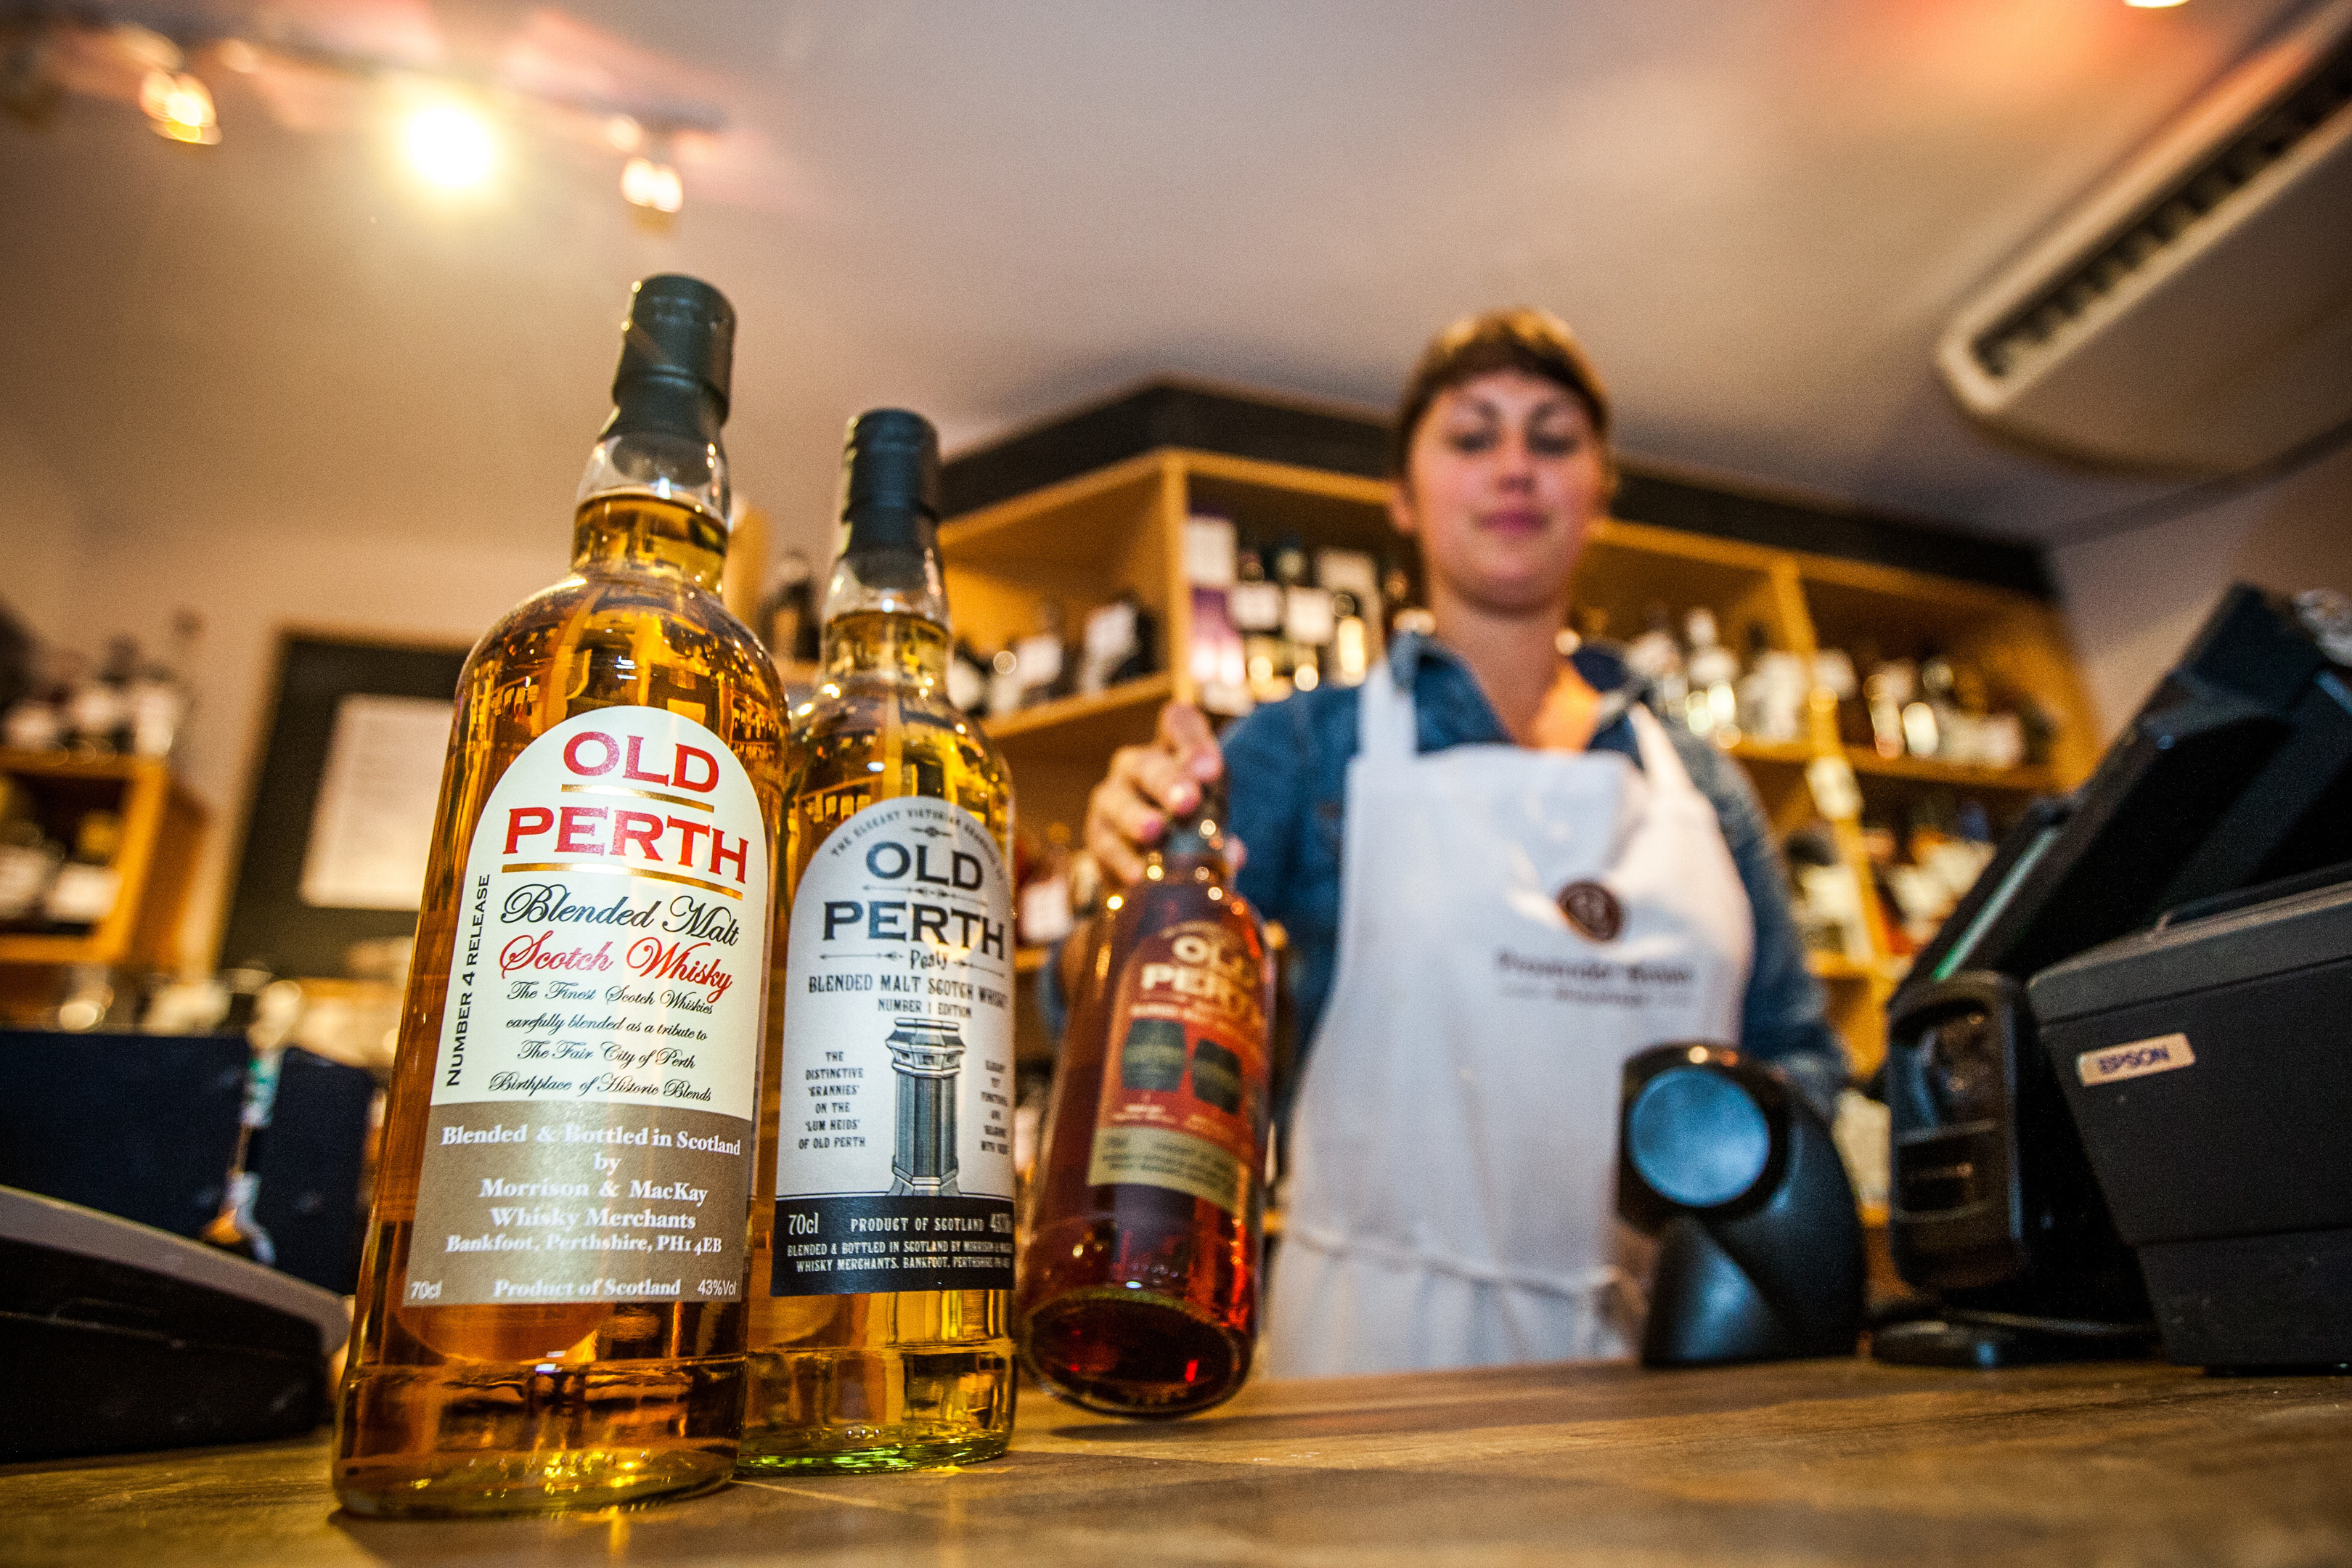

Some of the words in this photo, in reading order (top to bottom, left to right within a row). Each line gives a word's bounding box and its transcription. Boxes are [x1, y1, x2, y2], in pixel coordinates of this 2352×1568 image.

[563, 731, 719, 793] OLD
[503, 807, 748, 883] PERTH
[831, 836, 852, 857] THE
[865, 841, 983, 891] OLD
[466, 874, 490, 966] RELEASE
[500, 883, 661, 927] Blended
[662, 895, 740, 946] Malt
[822, 900, 1004, 961] PERTH
[462, 971, 475, 987] 4
[499, 931, 616, 979] Scotch
[626, 937, 733, 1003] Whisky
[507, 981, 539, 1000] The
[545, 981, 595, 1001] Finest
[605, 986, 656, 1005] Scotch
[660, 990, 713, 1015] Whiskies
[809, 975, 872, 993] BLENDED
[880, 976, 921, 993] MALT
[928, 978, 974, 1000] SCOTCH
[878, 998, 923, 1013] NUMBER
[937, 1003, 972, 1018] EDITION
[506, 1013, 565, 1035] carefully
[568, 1013, 625, 1031] blended
[626, 1022, 642, 1032] as
[657, 1024, 695, 1039] tribute
[697, 1031, 708, 1041] to
[446, 992, 473, 1087] NUMBER
[517, 1040, 550, 1060] The
[552, 1040, 594, 1060] Fair
[601, 1041, 635, 1070] City
[639, 1045, 655, 1068] of
[655, 1048, 695, 1069] Perth
[825, 1051, 844, 1062] THE
[2099, 1045, 2171, 1074] EPSON
[805, 1068, 864, 1079] DISTINCTIVE
[489, 1071, 572, 1099] Birthplace
[579, 1073, 599, 1097] of
[597, 1073, 659, 1097] Historic
[663, 1079, 711, 1103] Blends
[815, 1102, 828, 1114] ON
[831, 1101, 850, 1113] THE
[441, 1124, 528, 1146] Blended
[536, 1126, 557, 1143] &
[563, 1123, 648, 1146] Bottled
[652, 1129, 671, 1148] in
[676, 1132, 741, 1156] Scotland
[799, 1138, 810, 1150] OF
[813, 1137, 830, 1149] OLD
[834, 1136, 866, 1148] PERTH
[593, 1152, 621, 1175] by
[478, 1177, 589, 1198] Morrison
[599, 1180, 619, 1199] &
[629, 1180, 709, 1207] MacKay
[489, 1206, 581, 1230] Whisky
[584, 1207, 696, 1229] Merchants
[788, 1212, 820, 1236] 70cl
[850, 1217, 909, 1233] PRODUCT
[914, 1217, 928, 1231] OF
[934, 1217, 984, 1232] SCOTLAND
[446, 1233, 540, 1253] Bankfoot,
[546, 1233, 653, 1254] Perthshire,
[693, 1237, 722, 1256] 4EB
[787, 1243, 828, 1257] BLENDED
[830, 1243, 837, 1254] &
[841, 1241, 886, 1254] BOTTLED
[889, 1241, 899, 1253] IN
[903, 1241, 948, 1253] SCOTLAND
[950, 1241, 962, 1252] BY
[796, 1259, 833, 1273] WHISKY
[410, 1281, 441, 1299] 70cl
[492, 1279, 573, 1299] Product
[579, 1278, 603, 1297] of
[603, 1278, 681, 1297] Scotland
